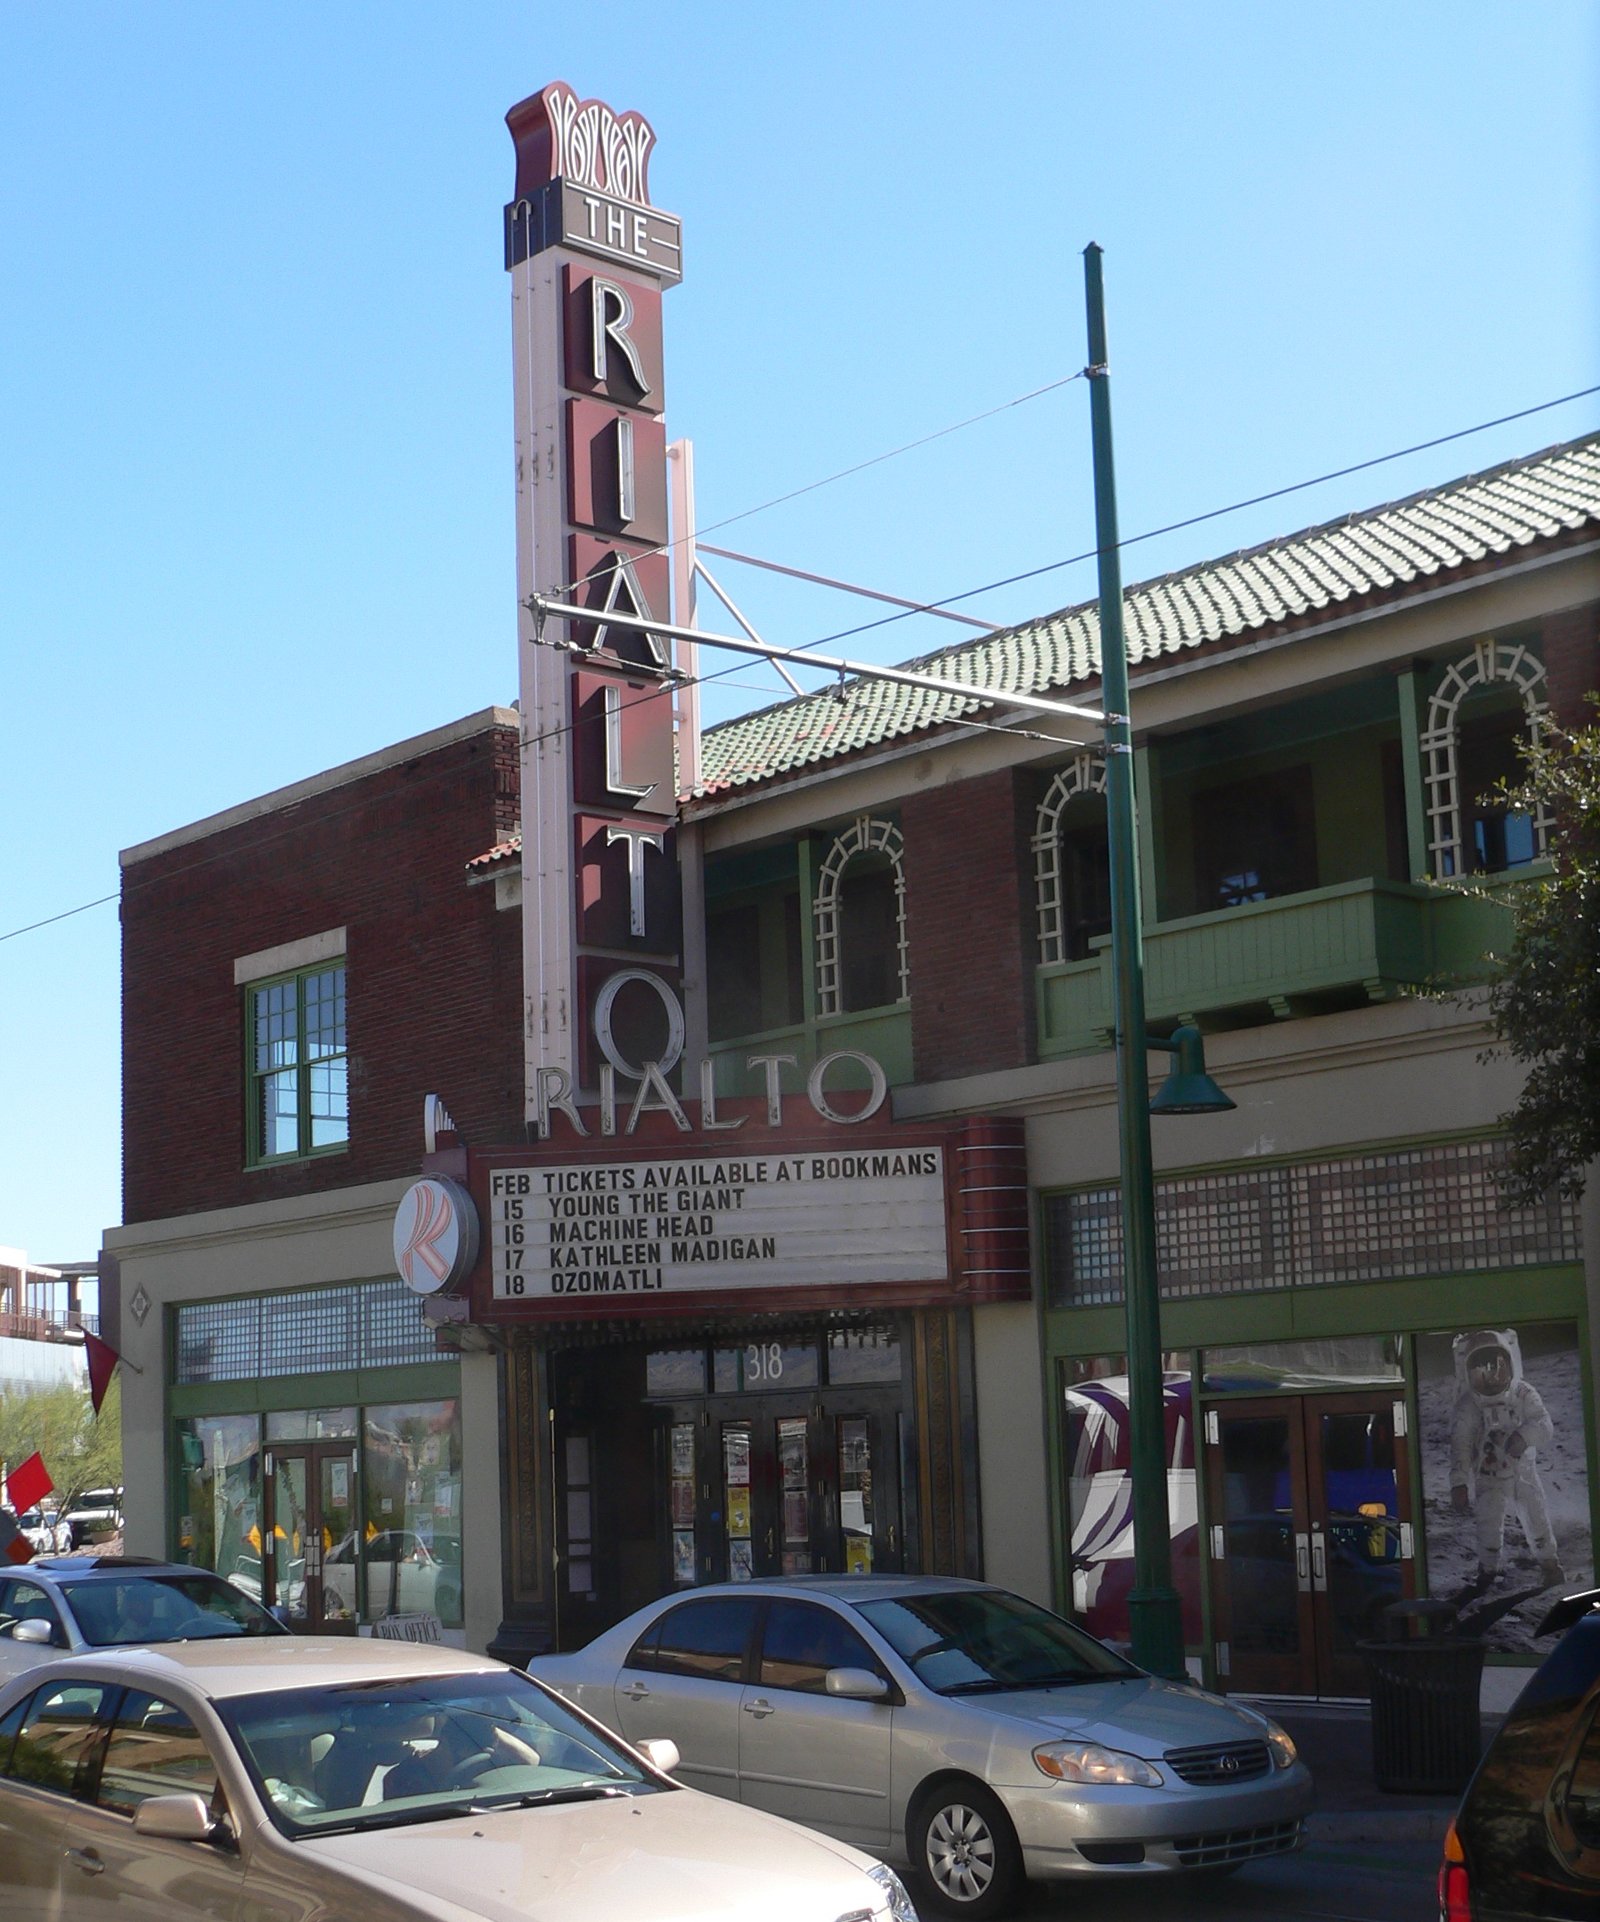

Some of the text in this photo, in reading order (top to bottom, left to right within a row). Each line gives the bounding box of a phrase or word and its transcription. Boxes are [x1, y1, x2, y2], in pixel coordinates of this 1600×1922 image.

[585, 197, 648, 256] THE
[590, 276, 686, 1080] RIALTO
[536, 1049, 887, 1139] RIALTO
[493, 1153, 937, 1196] FEB TICKETS AVAILABLE AT BOOKMANS
[504, 1188, 745, 1220] 15 YOUNG THE GIANT
[505, 1215, 713, 1245] 16 MACHINE HEAD
[505, 1237, 775, 1270] 17 KATHLEEN MADIGAN
[505, 1268, 662, 1295] 18 OZOMATLI
[748, 1342, 783, 1380] 318
[405, 1621, 441, 1642] OFFICE
